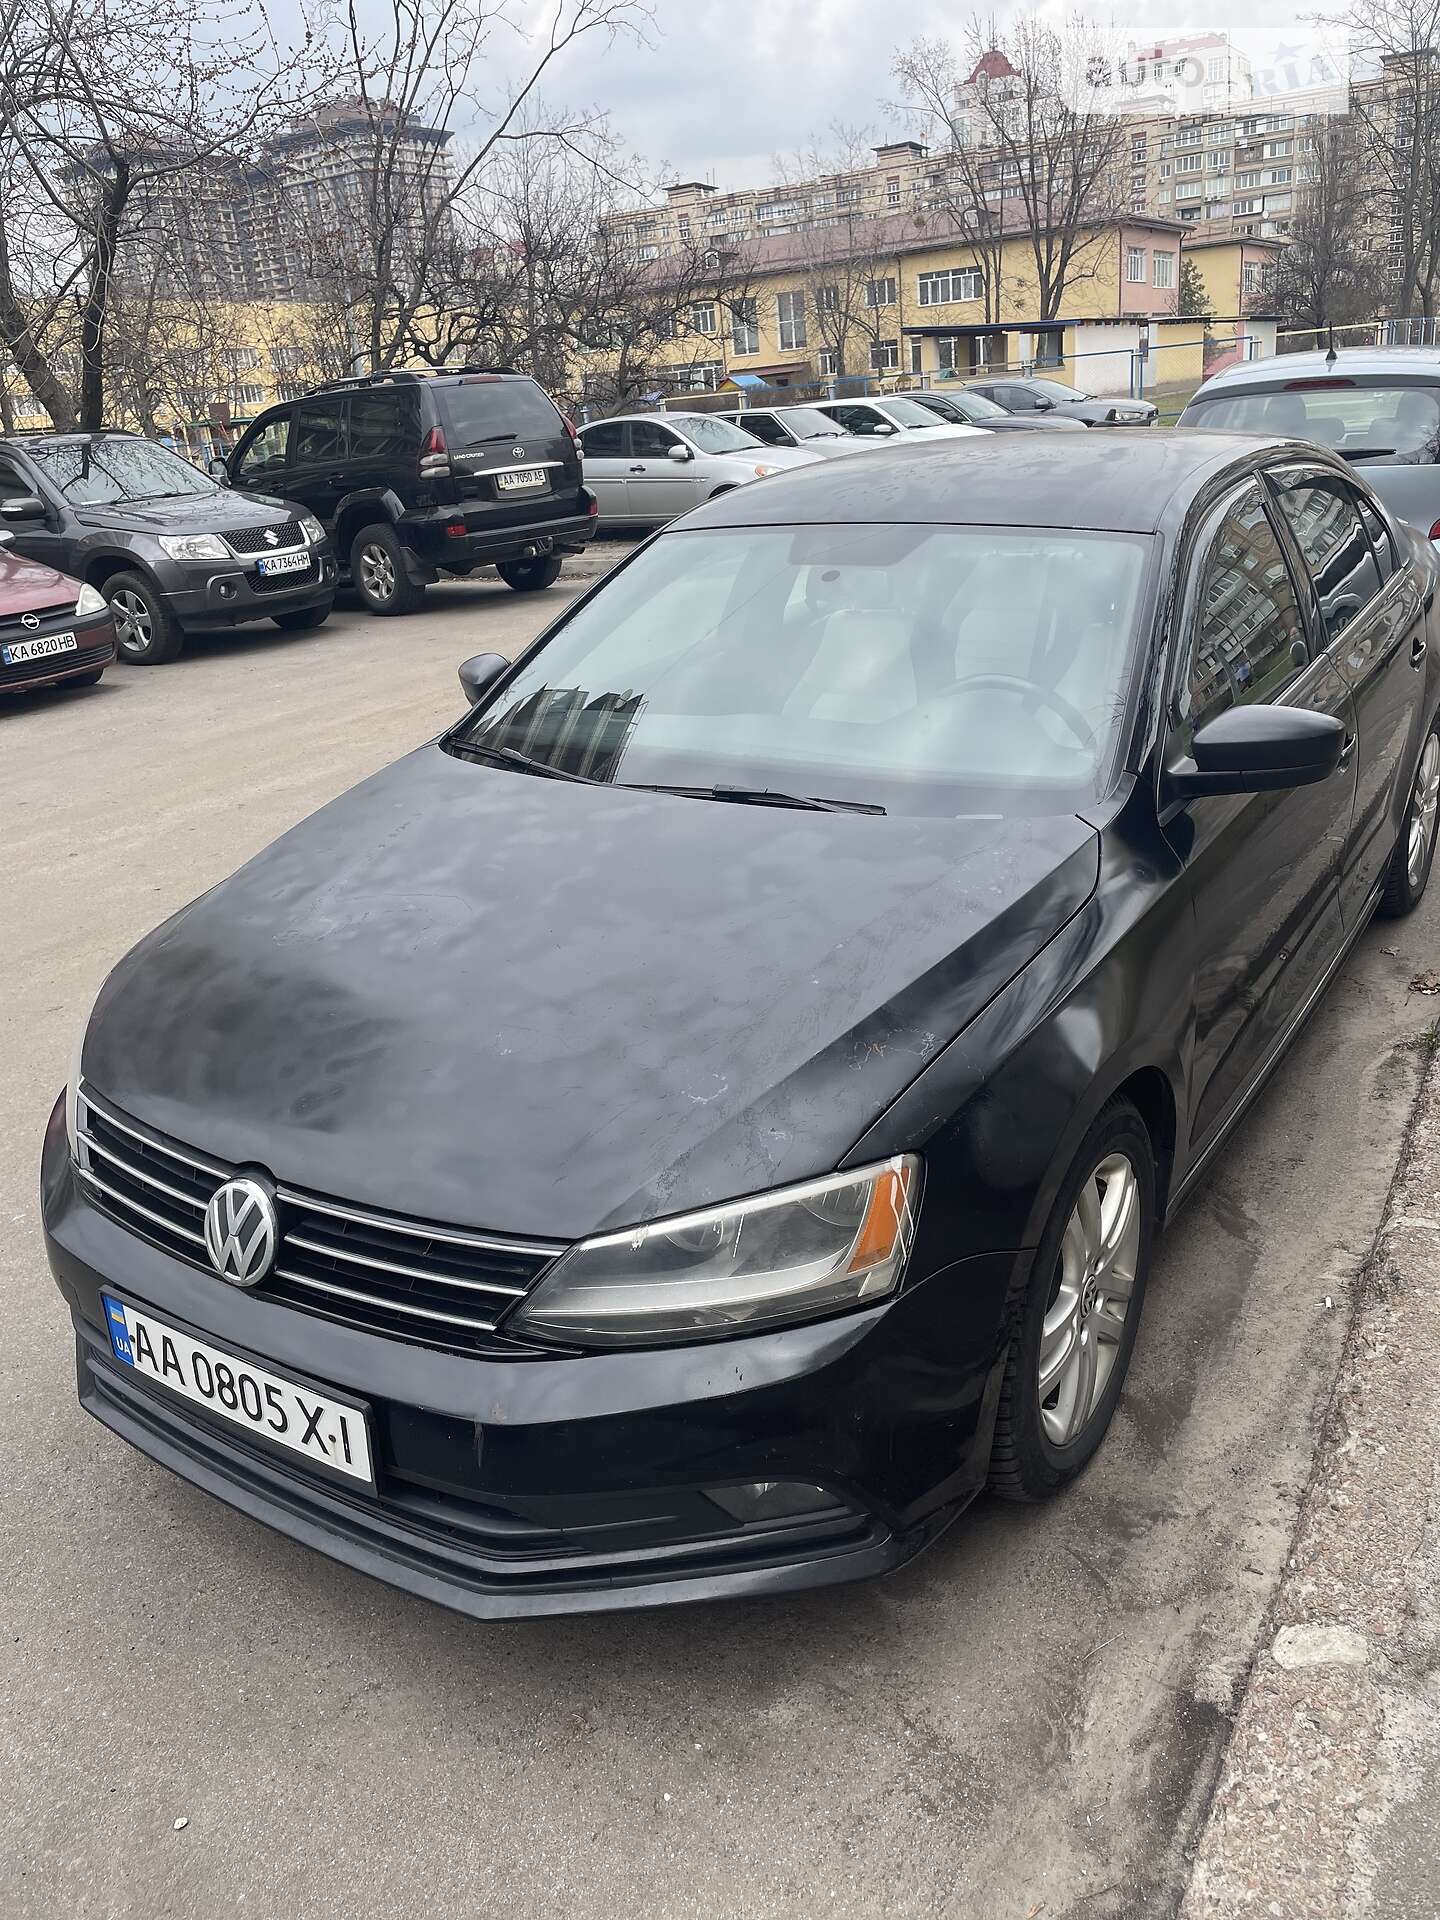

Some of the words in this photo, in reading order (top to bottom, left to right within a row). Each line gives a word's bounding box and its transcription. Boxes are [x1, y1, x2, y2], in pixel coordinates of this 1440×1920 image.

[503, 473, 514, 485] AA
[515, 471, 532, 483] 7050
[534, 470, 544, 481] AE
[263, 560, 277, 572] KA
[277, 556, 297, 569] 7364
[9, 645, 29, 661] KA
[31, 639, 58, 656] 6820
[58, 635, 75, 650] HB
[115, 1335, 132, 1356] UA
[135, 1321, 187, 1387] AA
[191, 1351, 288, 1433] 0805
[294, 1396, 353, 1465] XI
